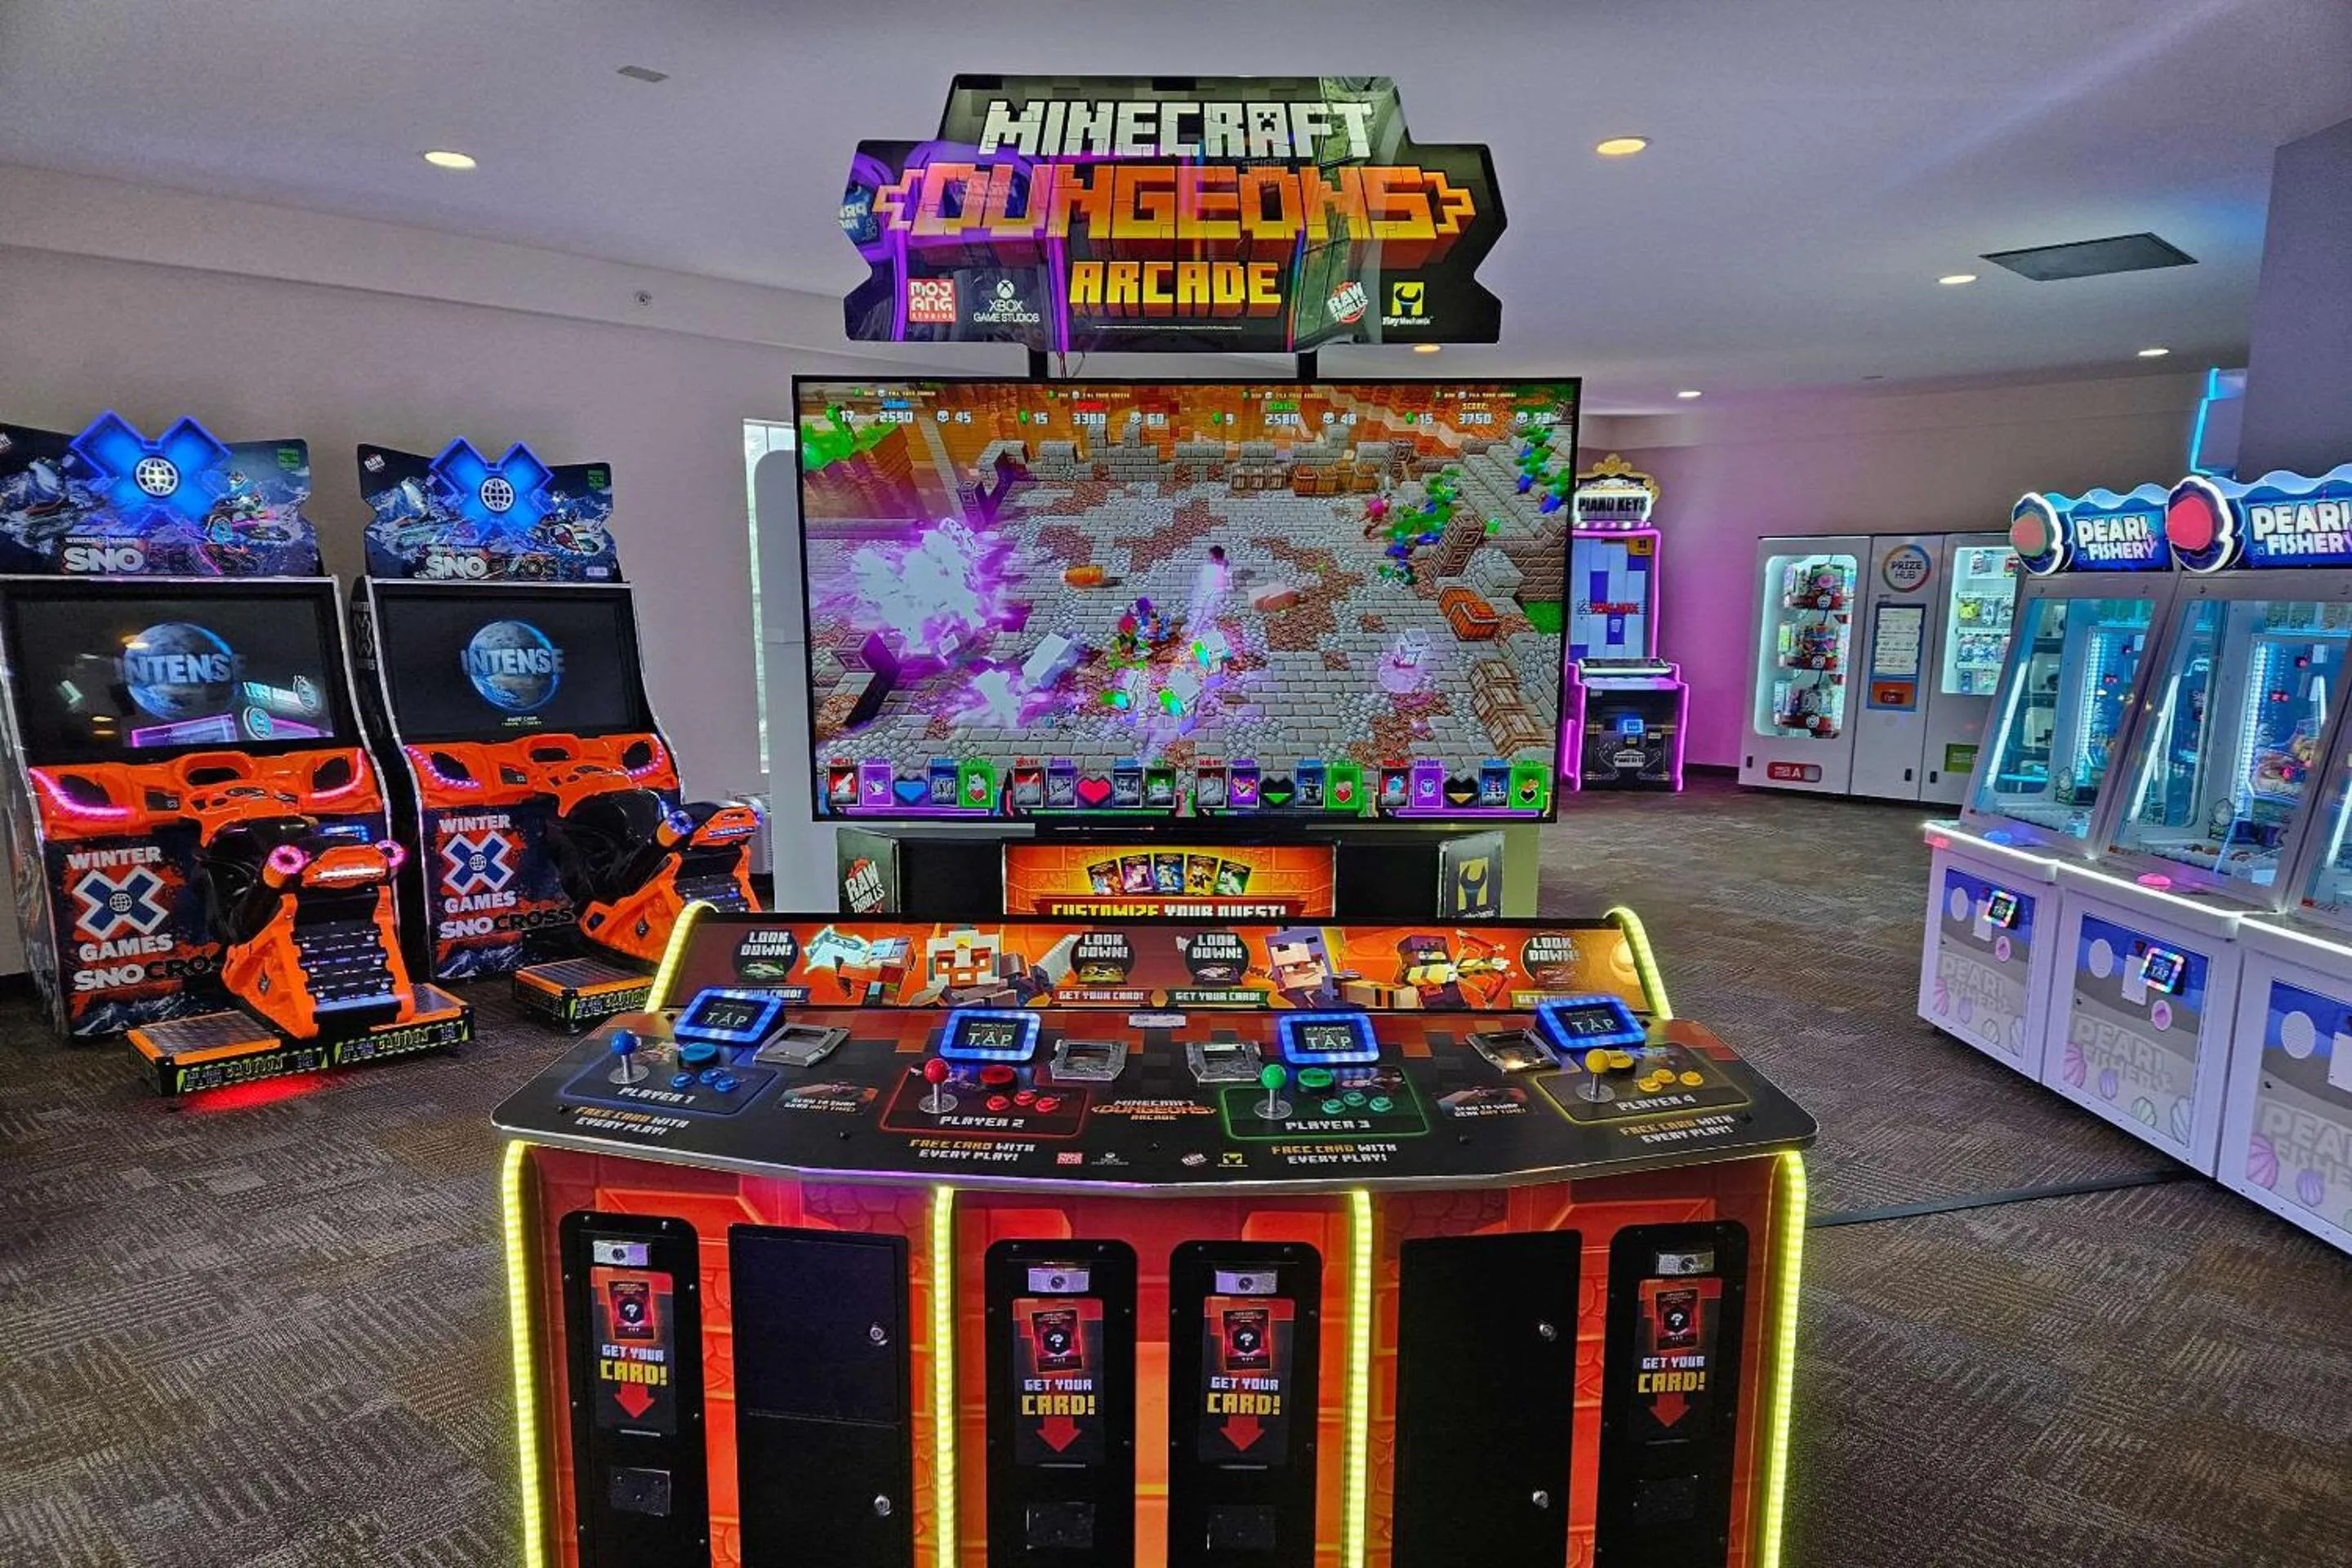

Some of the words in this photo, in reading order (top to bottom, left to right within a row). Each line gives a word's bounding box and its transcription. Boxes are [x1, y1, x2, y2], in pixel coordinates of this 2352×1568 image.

[979, 100, 1374, 158] MINECRAFT
[910, 163, 1442, 242] DUNGEONS
[1069, 261, 1281, 309] ARCADE
[1327, 281, 1367, 314] RAW
[989, 299, 1024, 312] XBOX
[973, 313, 1001, 323] GAME
[1002, 313, 1040, 323] STUDIOS
[1033, 412, 1049, 424] 15
[1071, 412, 1106, 425] 3300
[1578, 496, 1615, 512] PIANO
[1617, 496, 1647, 512] KEYS
[2075, 516, 2148, 547] PEARL
[2088, 542, 2156, 560] FISHERY
[1891, 561, 1923, 571] PRIZE
[460, 648, 565, 675] INTENSE
[439, 814, 511, 834] WINTER
[65, 846, 163, 870] WINTER
[844, 861, 880, 902] RAW
[444, 890, 517, 913] GAMES
[1051, 903, 1160, 917] CUSTOMIZE
[1164, 903, 1213, 917] YOUR
[749, 930, 791, 944] LOOK
[1084, 934, 1125, 947] LOOK
[1196, 933, 1237, 947] LOOK
[1531, 937, 1573, 949] LOOK
[79, 933, 174, 962] GAMES
[740, 942, 793, 956] DOWN!
[1078, 946, 1129, 960] DOWN!
[1192, 946, 1243, 960] DOWN!
[1528, 949, 1582, 962] DOWN!
[1058, 991, 1082, 1001] GET
[1083, 991, 1113, 1002] YOUR
[1115, 991, 1144, 1002] CARD!
[1175, 991, 1197, 1002] GET
[1199, 991, 1227, 1002] YOUR
[1229, 991, 1261, 1002] CARD!
[704, 1013, 749, 1027] TAP
[1570, 1018, 1615, 1034] TAP
[377, 1027, 429, 1050] CAUTION
[969, 1031, 1013, 1045] TAP
[1306, 1035, 1352, 1049] TAP
[225, 1058, 283, 1079] CAUTION
[617, 1087, 684, 1102] PLAYER
[684, 1095, 697, 1104] 1
[1617, 1095, 1682, 1111] PLAYER
[1682, 1094, 1696, 1104] 4
[574, 1106, 614, 1119] FREE
[651, 1116, 691, 1129] WITH
[575, 1116, 626, 1129] EVERY
[939, 1116, 1008, 1127] PLAYER
[1011, 1118, 1025, 1128] 2
[1696, 1114, 1735, 1126] WITH
[1285, 1120, 1352, 1131] PLAYER
[1353, 1120, 1372, 1130] 3
[1640, 1129, 1689, 1143] EVERY
[1688, 1125, 1735, 1138] PLAY!
[909, 1138, 952, 1149] FREE
[953, 1140, 994, 1151] CARD
[995, 1143, 1036, 1152] WITH
[1271, 1144, 1312, 1156] FREE
[1313, 1143, 1356, 1155] CARD
[1356, 1143, 1397, 1153] WITH
[919, 1148, 972, 1160] EVERY
[973, 1150, 1018, 1161] PLAY!
[1286, 1153, 1340, 1165] EVERY
[1341, 1152, 1388, 1164] PLAY!
[601, 1345, 629, 1358] GET
[630, 1347, 664, 1361] YOUR
[1642, 1356, 1668, 1370] GET
[1670, 1355, 1704, 1368] YOUR
[599, 1359, 667, 1387] CARD!
[1025, 1379, 1050, 1391] GET
[1054, 1379, 1092, 1391] YOUR
[1210, 1376, 1237, 1389] GET
[1241, 1377, 1279, 1391] YOUR
[1637, 1371, 1706, 1394] CARD!
[1022, 1393, 1095, 1415] CARD!
[1206, 1392, 1281, 1415] CARD!
